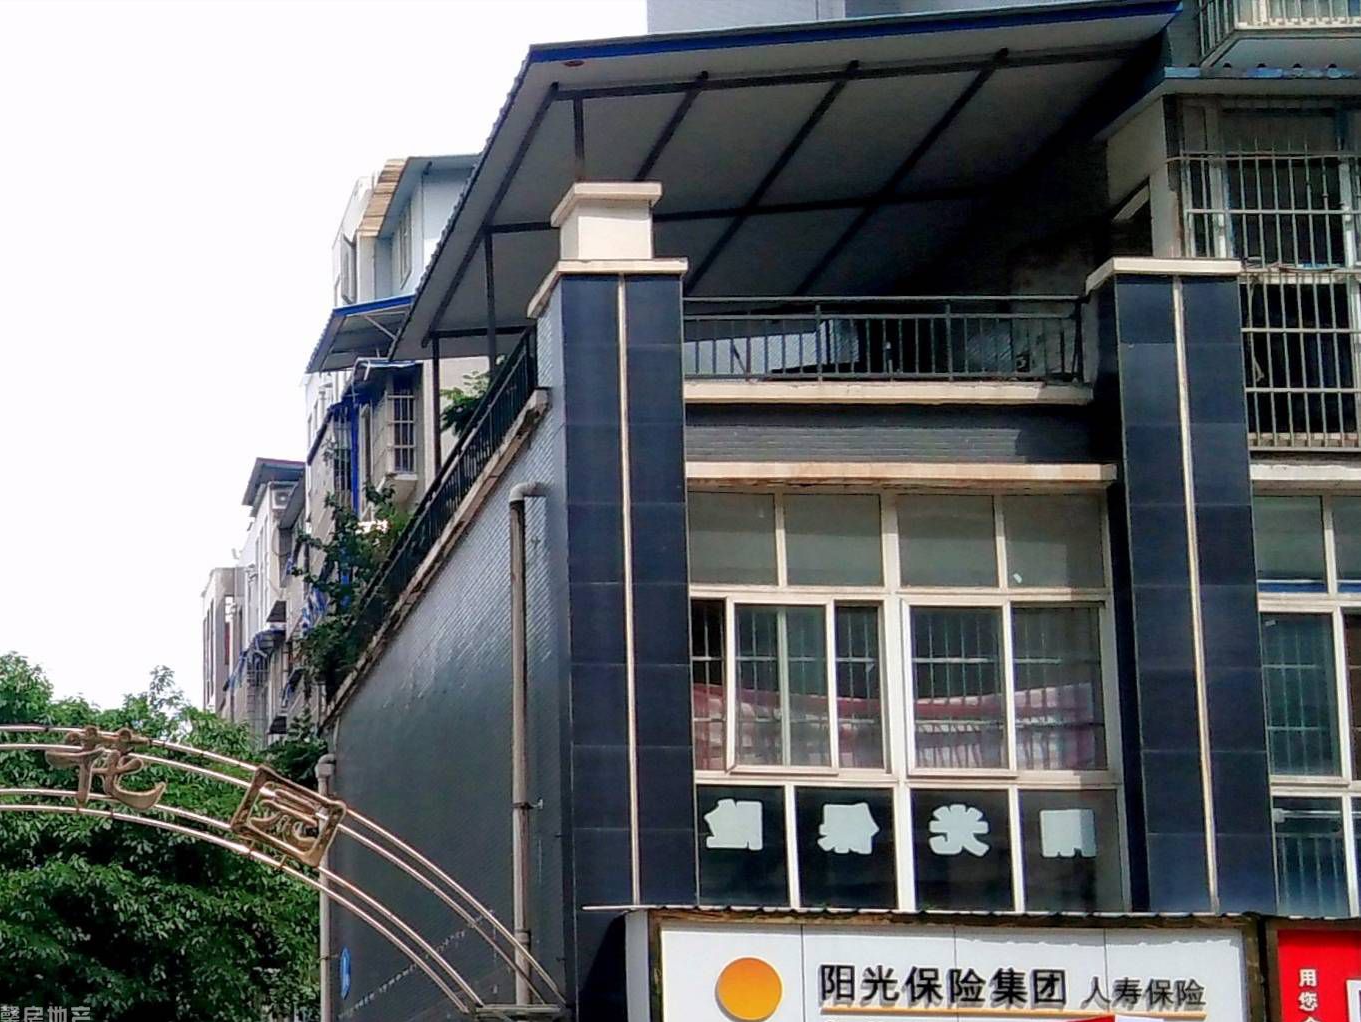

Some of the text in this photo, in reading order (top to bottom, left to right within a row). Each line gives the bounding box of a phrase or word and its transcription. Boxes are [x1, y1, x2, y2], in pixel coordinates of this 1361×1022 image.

[819, 964, 1207, 1007] 阳光保险集团 人寿保险
